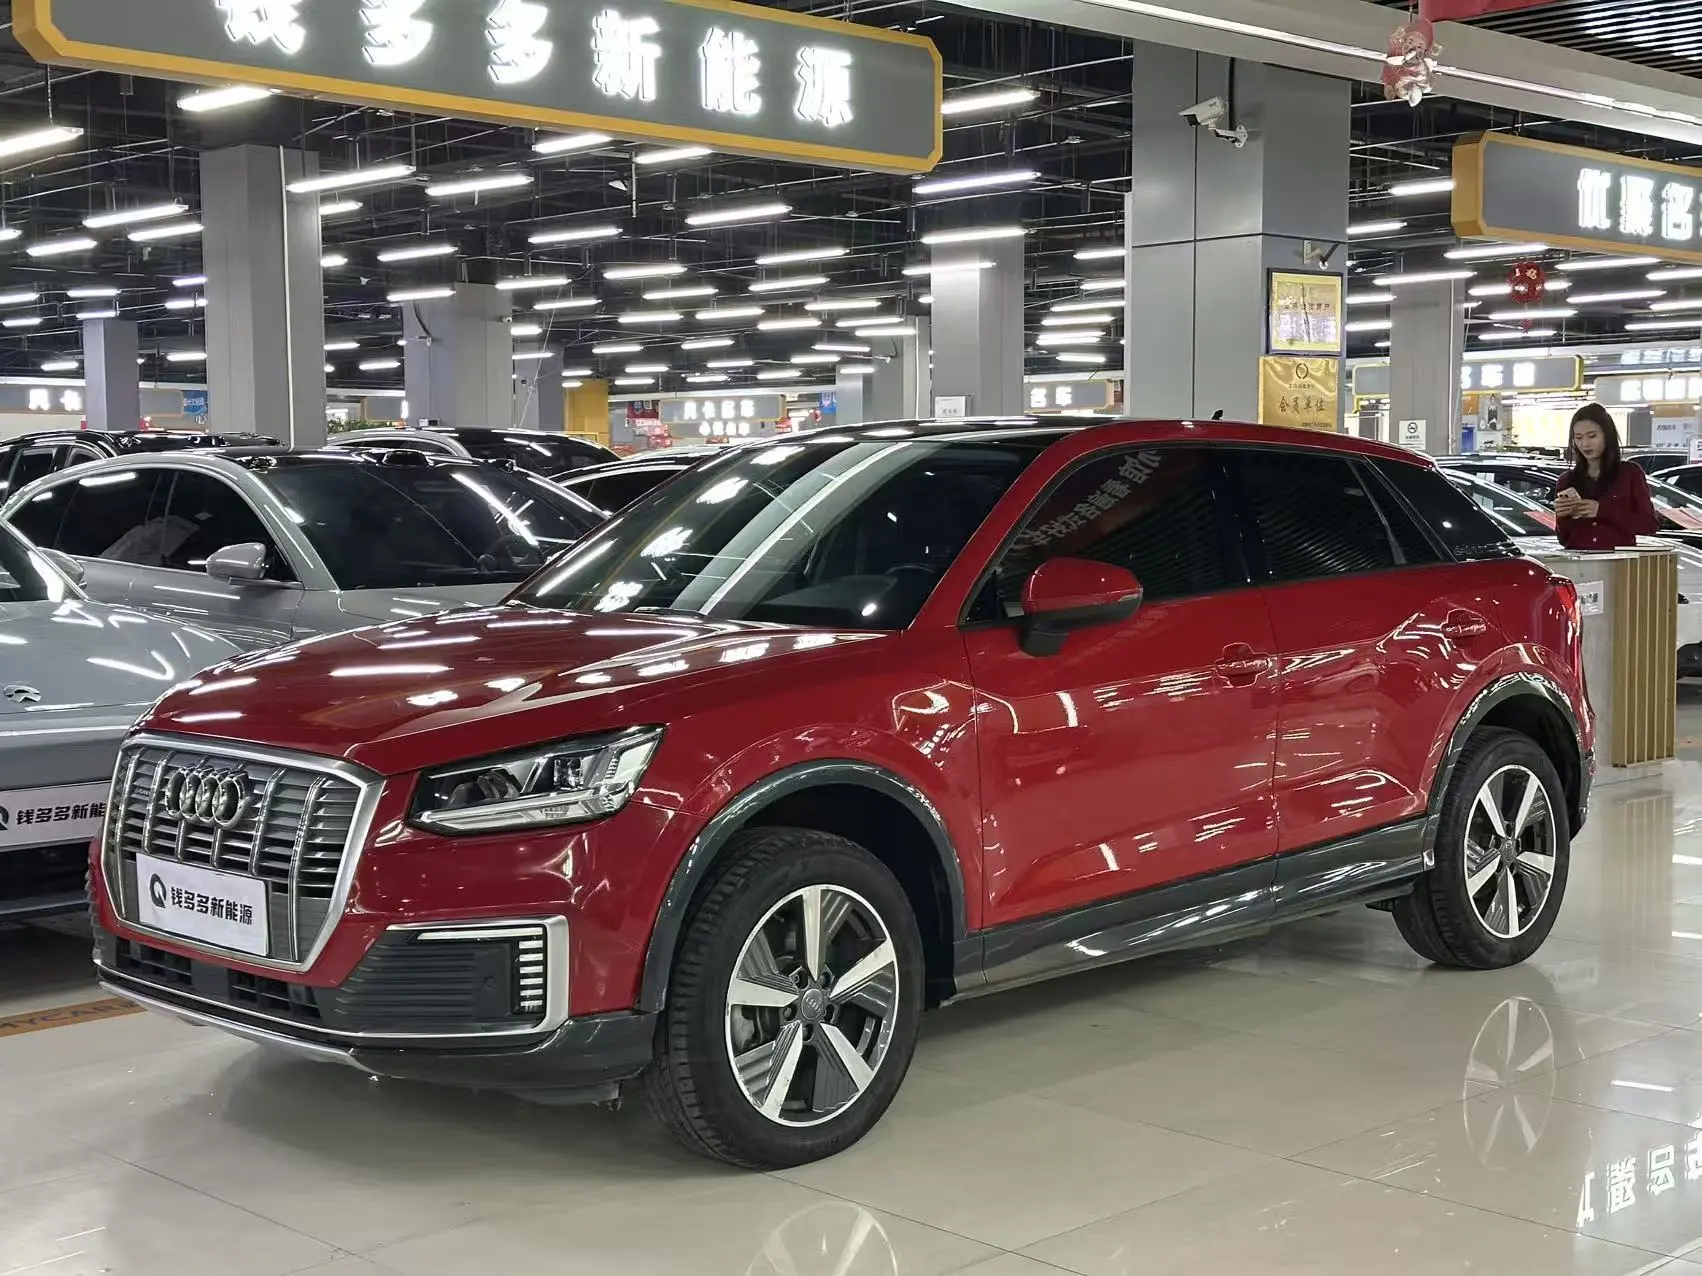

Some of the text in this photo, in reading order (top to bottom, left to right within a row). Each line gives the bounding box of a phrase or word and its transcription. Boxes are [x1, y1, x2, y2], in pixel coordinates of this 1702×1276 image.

[171, 888, 253, 925] 钱多多新能源
